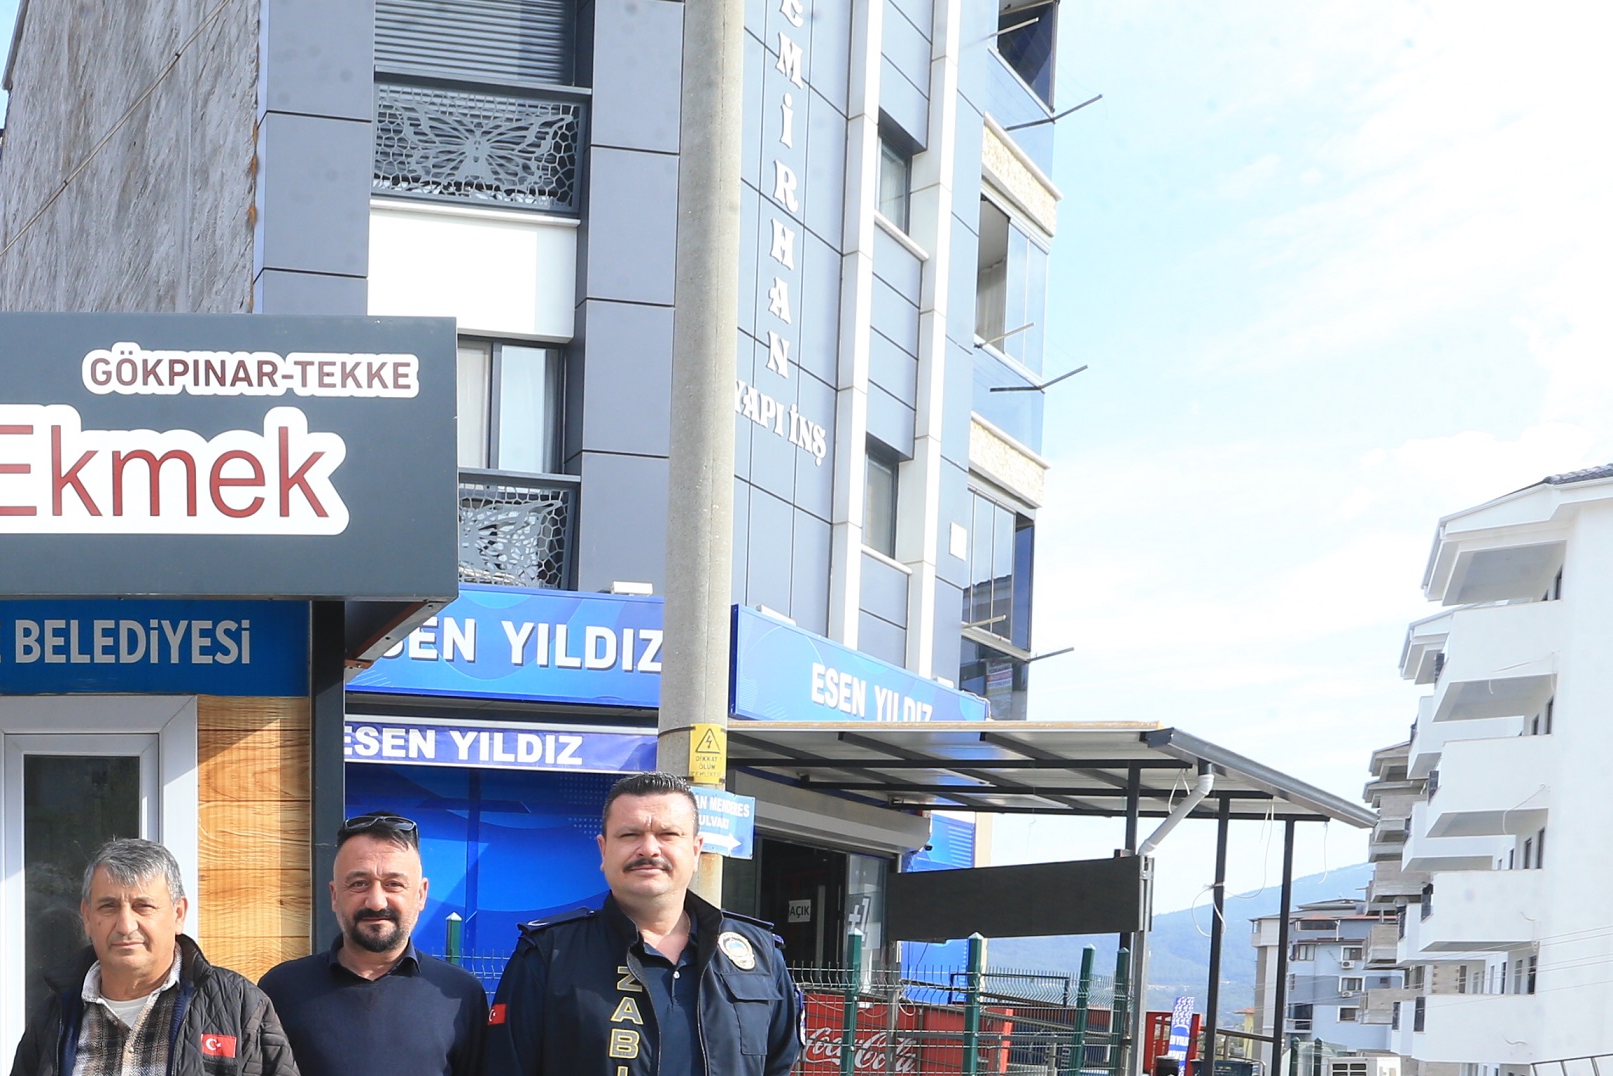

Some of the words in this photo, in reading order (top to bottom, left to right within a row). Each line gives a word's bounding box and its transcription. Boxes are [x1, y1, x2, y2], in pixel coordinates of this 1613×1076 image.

[90, 350, 412, 390] GÖKPINAR-TEKKE
[382, 616, 476, 662] EN
[501, 620, 664, 673] YILDIZ
[811, 662, 867, 719] ESEN
[449, 730, 584, 766] YILDIZ
[698, 814, 730, 830] ULVARI
[789, 906, 810, 918] AÇIK
